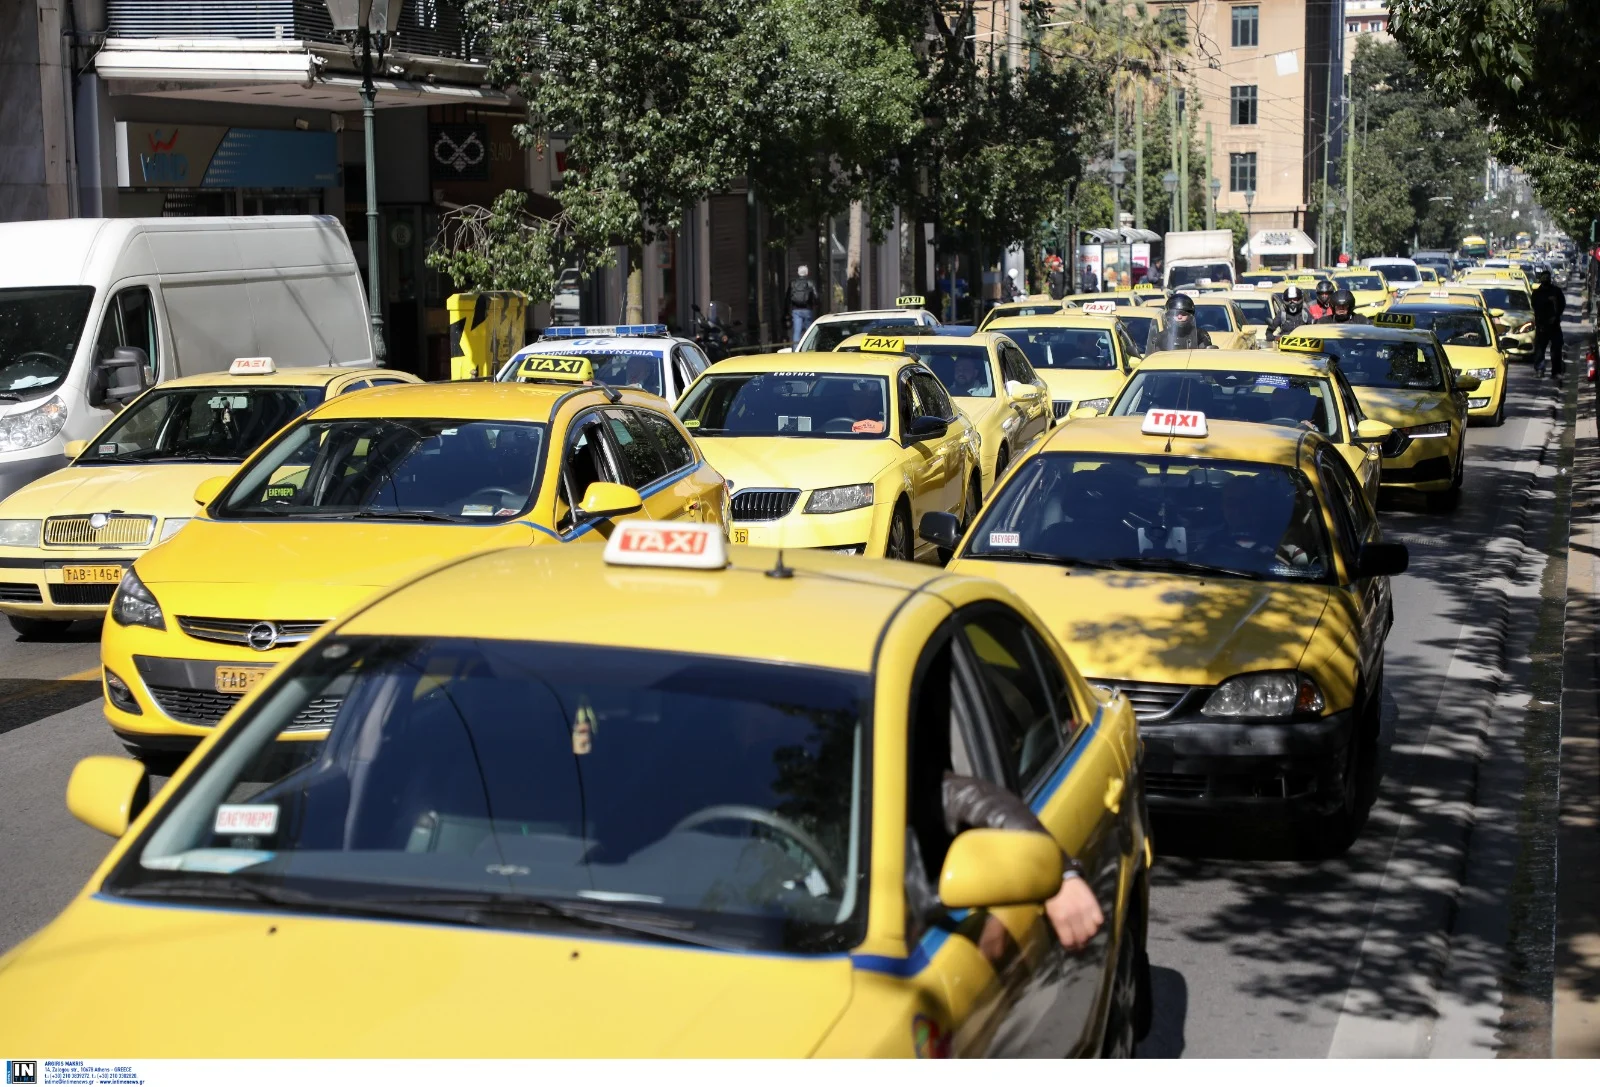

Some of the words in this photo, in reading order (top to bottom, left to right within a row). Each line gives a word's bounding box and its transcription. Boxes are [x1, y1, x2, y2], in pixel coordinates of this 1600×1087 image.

[1380, 313, 1409, 323] TAXI
[863, 338, 899, 348] TAXI
[1282, 336, 1318, 348] TAXI
[530, 358, 581, 372] TAXI
[1151, 412, 1199, 428] TAXI
[623, 530, 705, 553] TAXI
